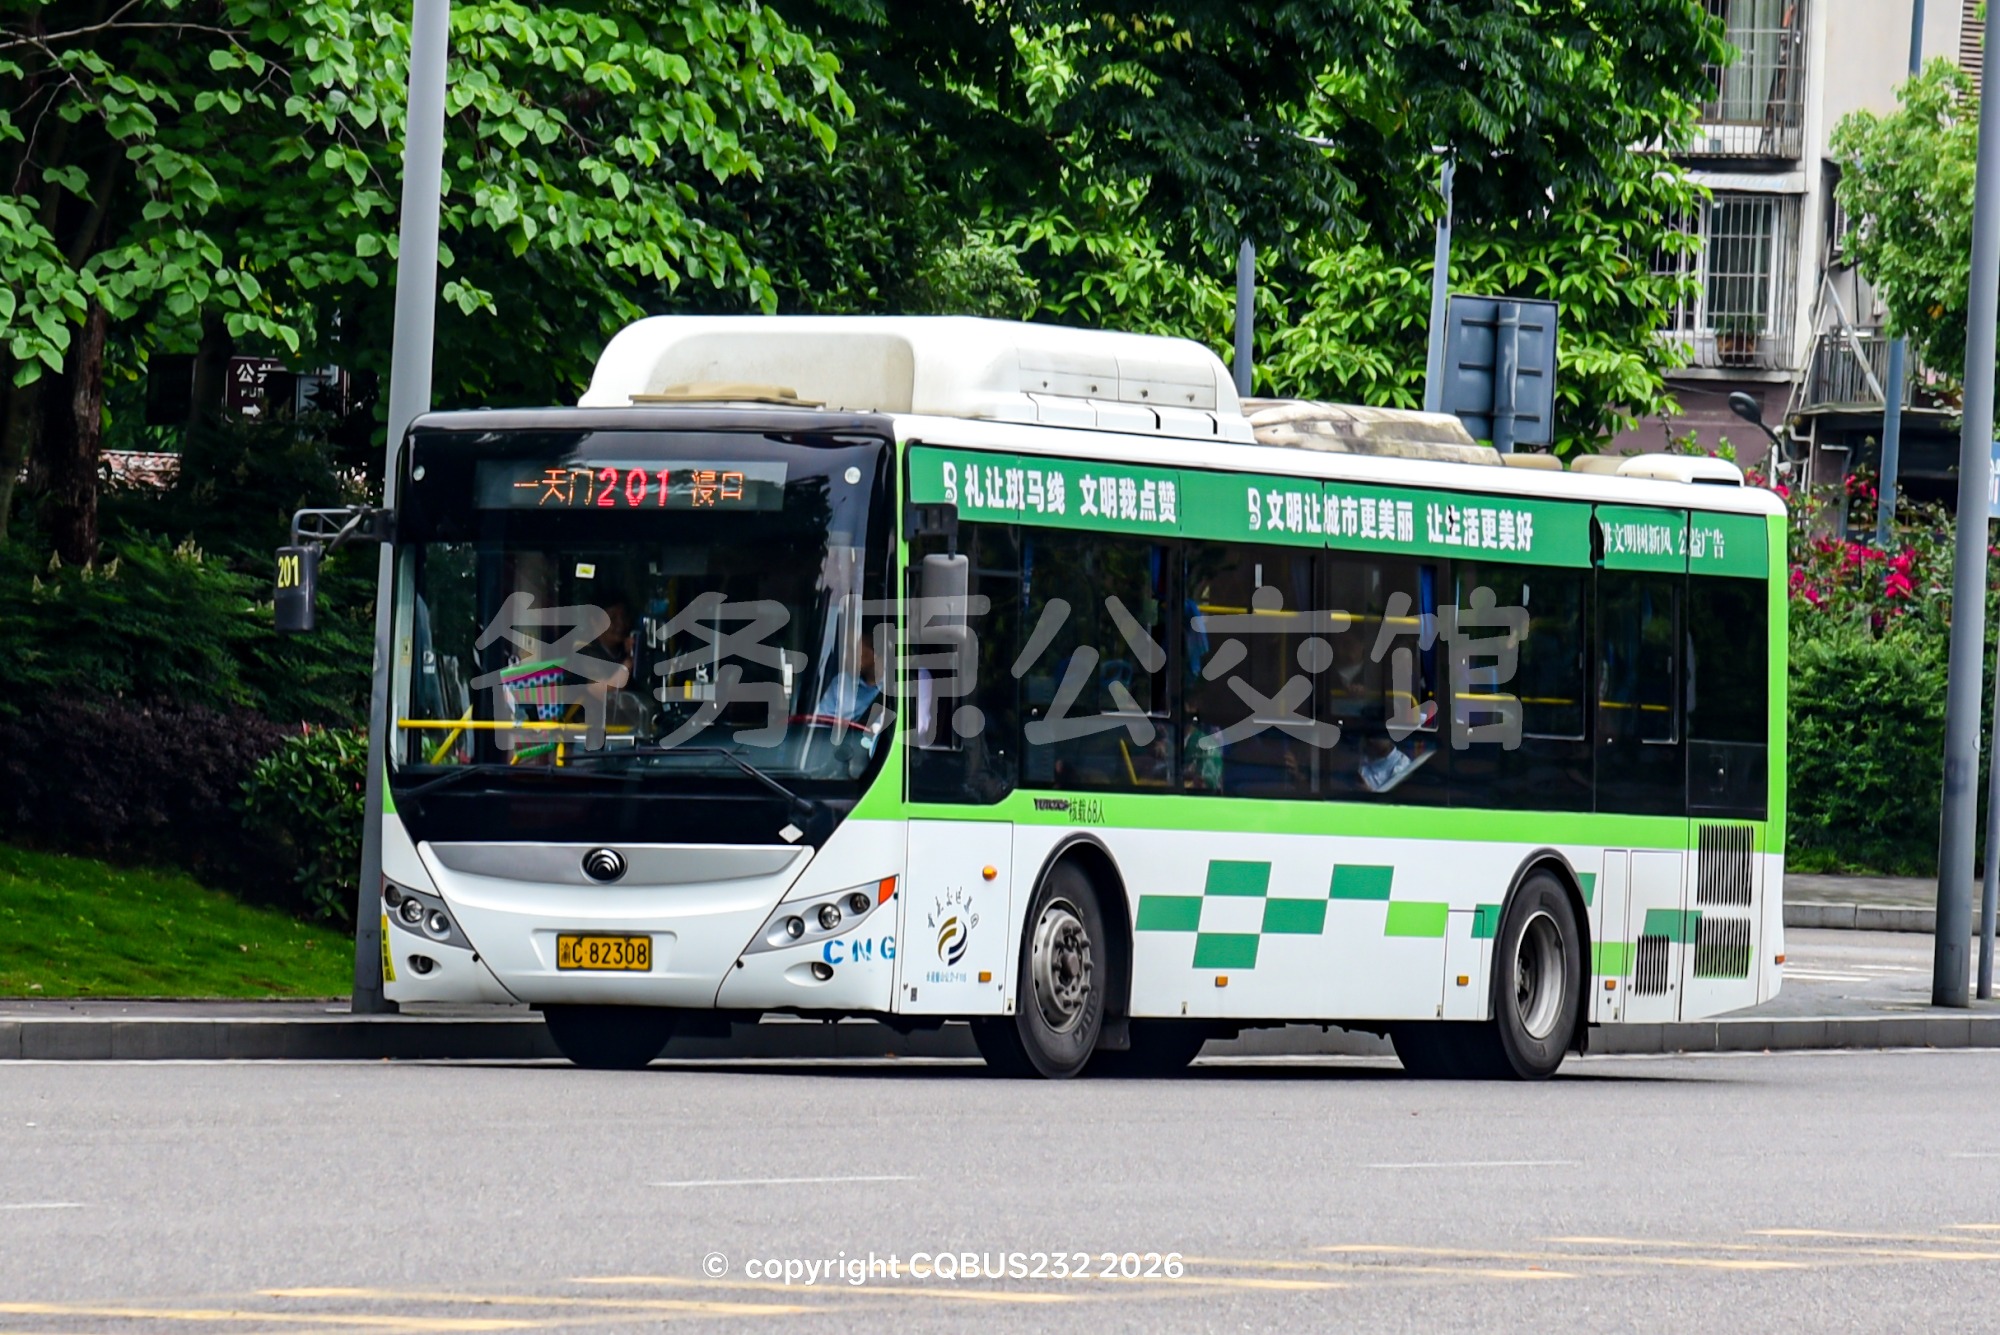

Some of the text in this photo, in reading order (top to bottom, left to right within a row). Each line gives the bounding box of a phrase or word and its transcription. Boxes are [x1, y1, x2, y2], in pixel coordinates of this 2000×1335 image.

[513, 468, 594, 506] 一天门
[597, 467, 671, 507] 201
[964, 463, 1177, 524] 礼让斑马线 文明我点赞
[1266, 489, 1534, 552] 文明让城市更美丽 让生活更美好
[277, 555, 299, 588] 201
